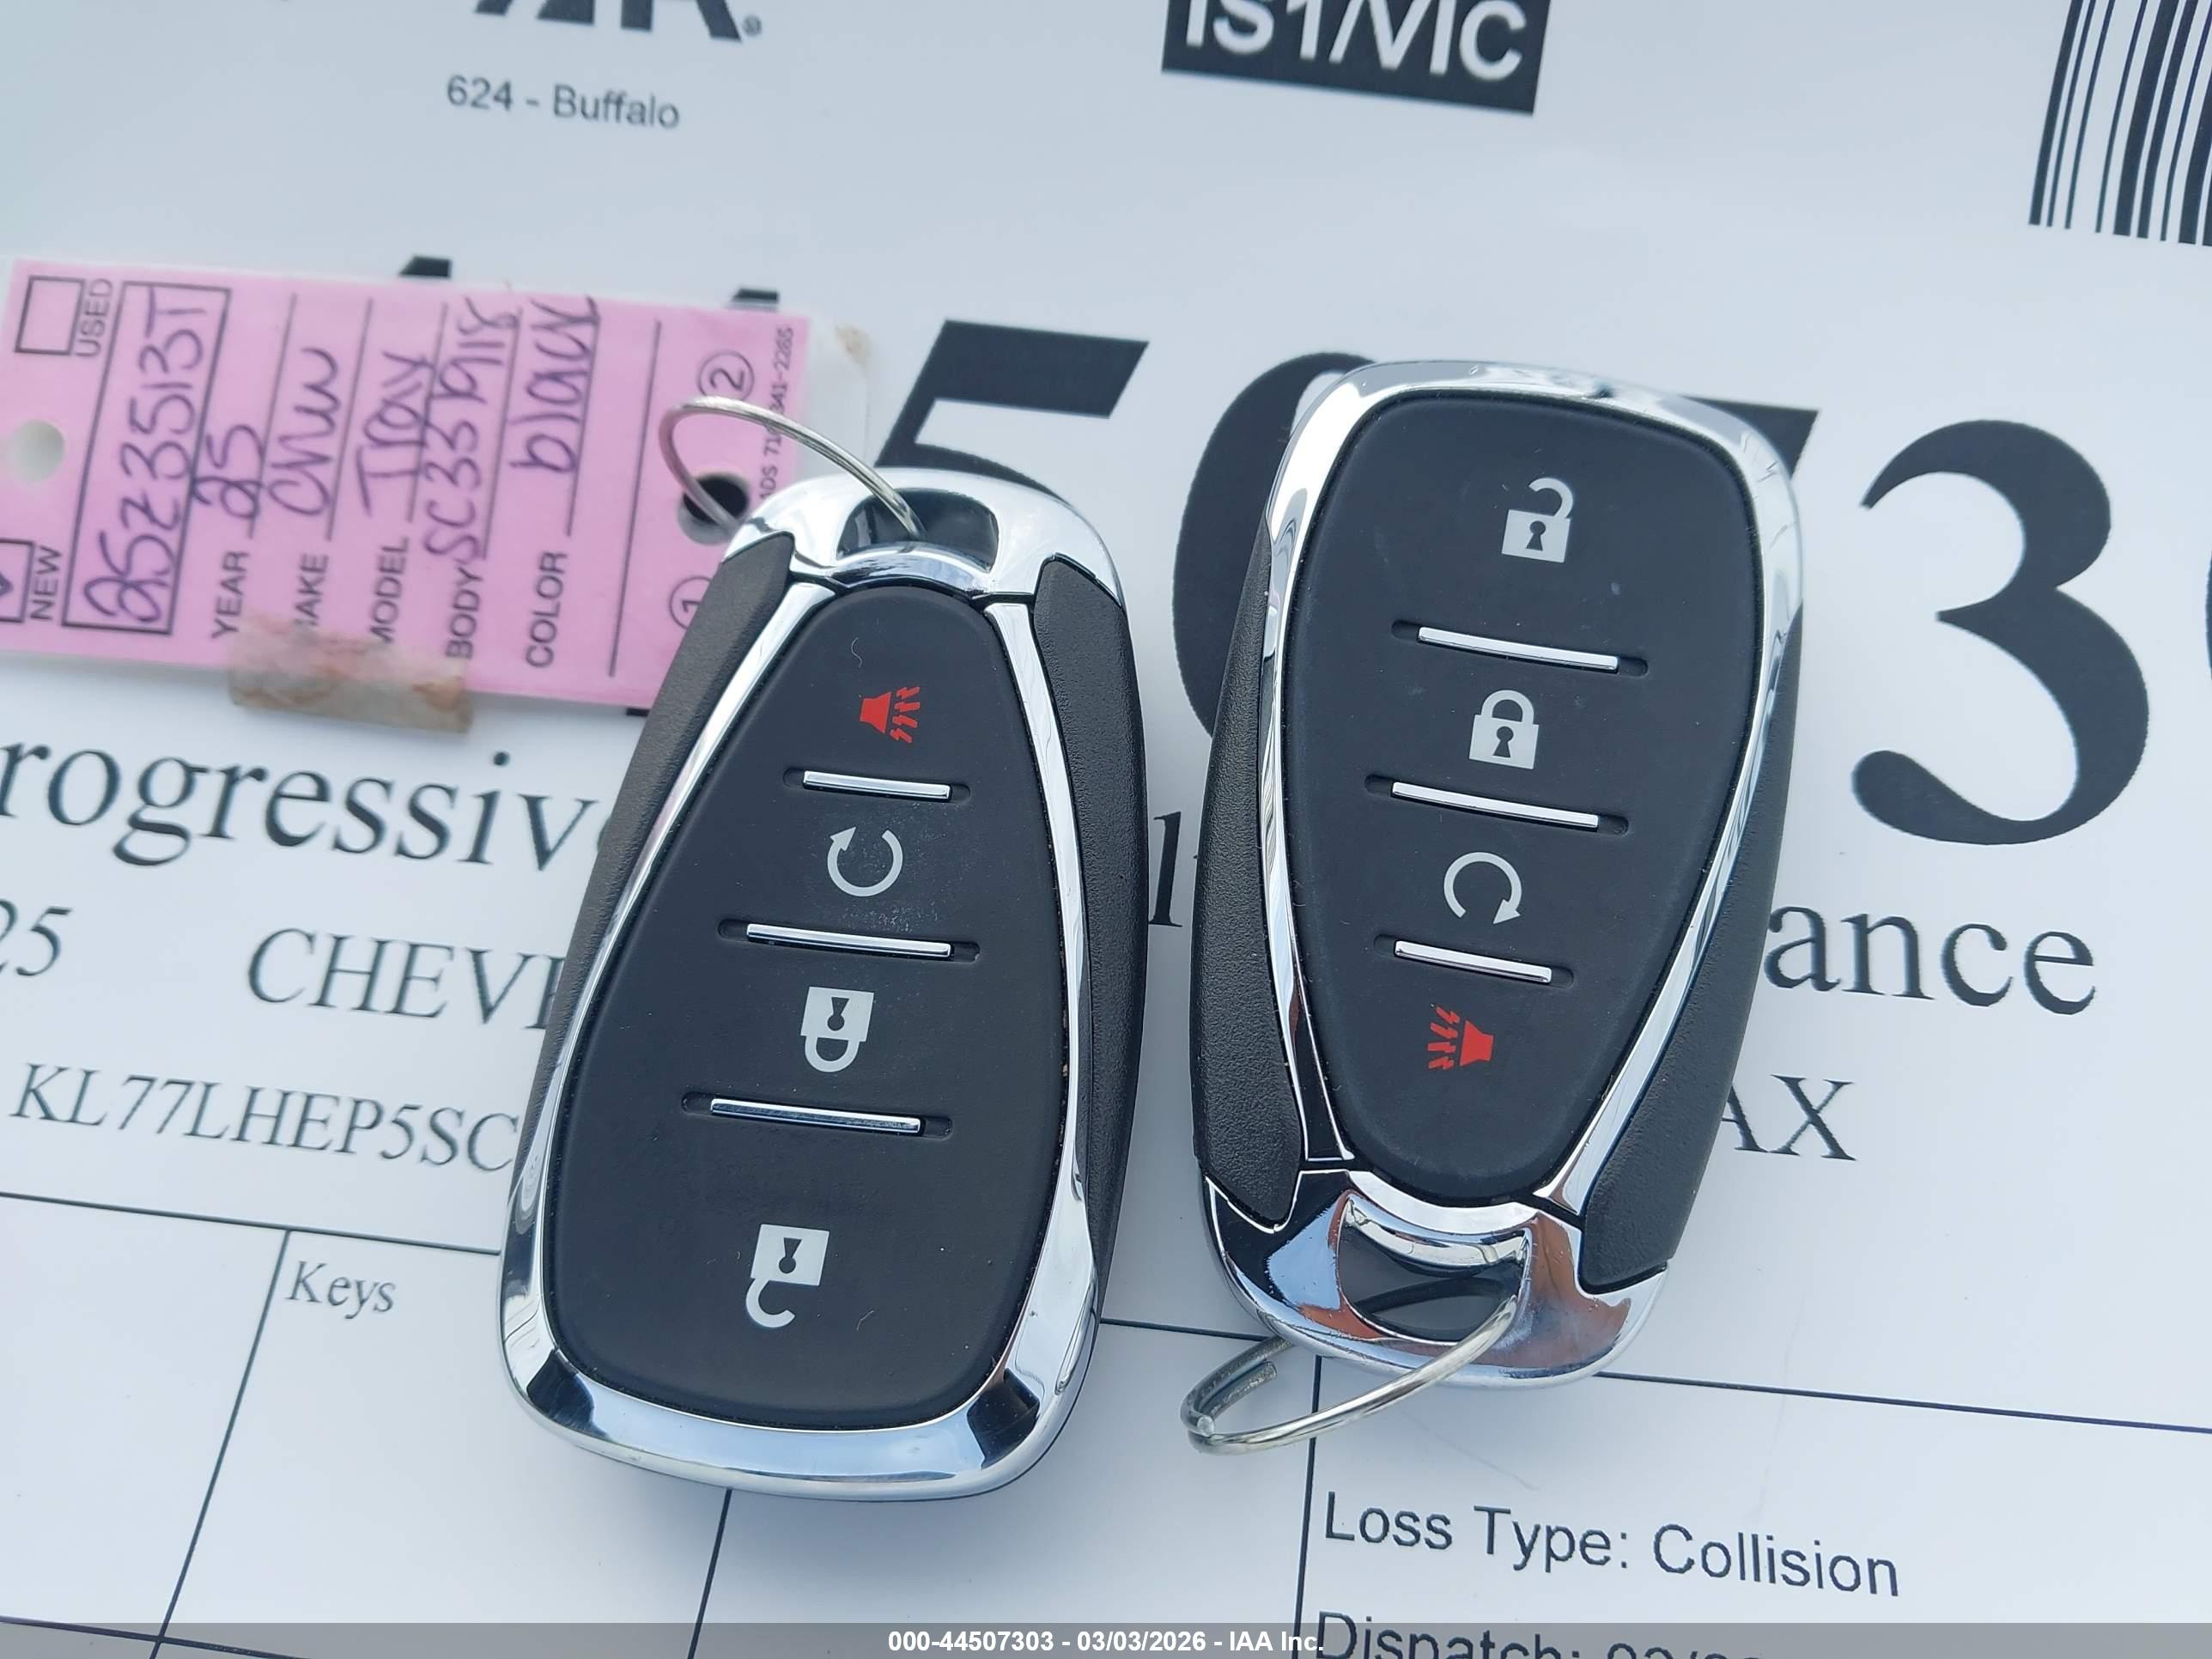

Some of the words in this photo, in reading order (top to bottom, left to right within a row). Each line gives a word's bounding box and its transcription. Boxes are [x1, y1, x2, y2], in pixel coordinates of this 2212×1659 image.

[447, 75, 514, 112] 624
[552, 83, 680, 129] Buffalo
[75, 279, 112, 356] USED
[510, 295, 600, 474] black
[191, 425, 264, 521] 25
[30, 546, 63, 621] NEW
[211, 550, 252, 640] YEAR
[444, 565, 483, 660] BODY
[526, 551, 568, 668] COLOR
[0, 741, 606, 868] rogressiv
[1765, 905, 2097, 1016] ance
[9, 1063, 519, 1172] KL77LHEP5SC
[1720, 1073, 1857, 1161] AX
[286, 1260, 396, 1320] Keys
[1325, 1491, 1453, 1551] Loss
[1473, 1504, 1628, 1574] Type:
[1652, 1523, 1899, 1597] Collision
